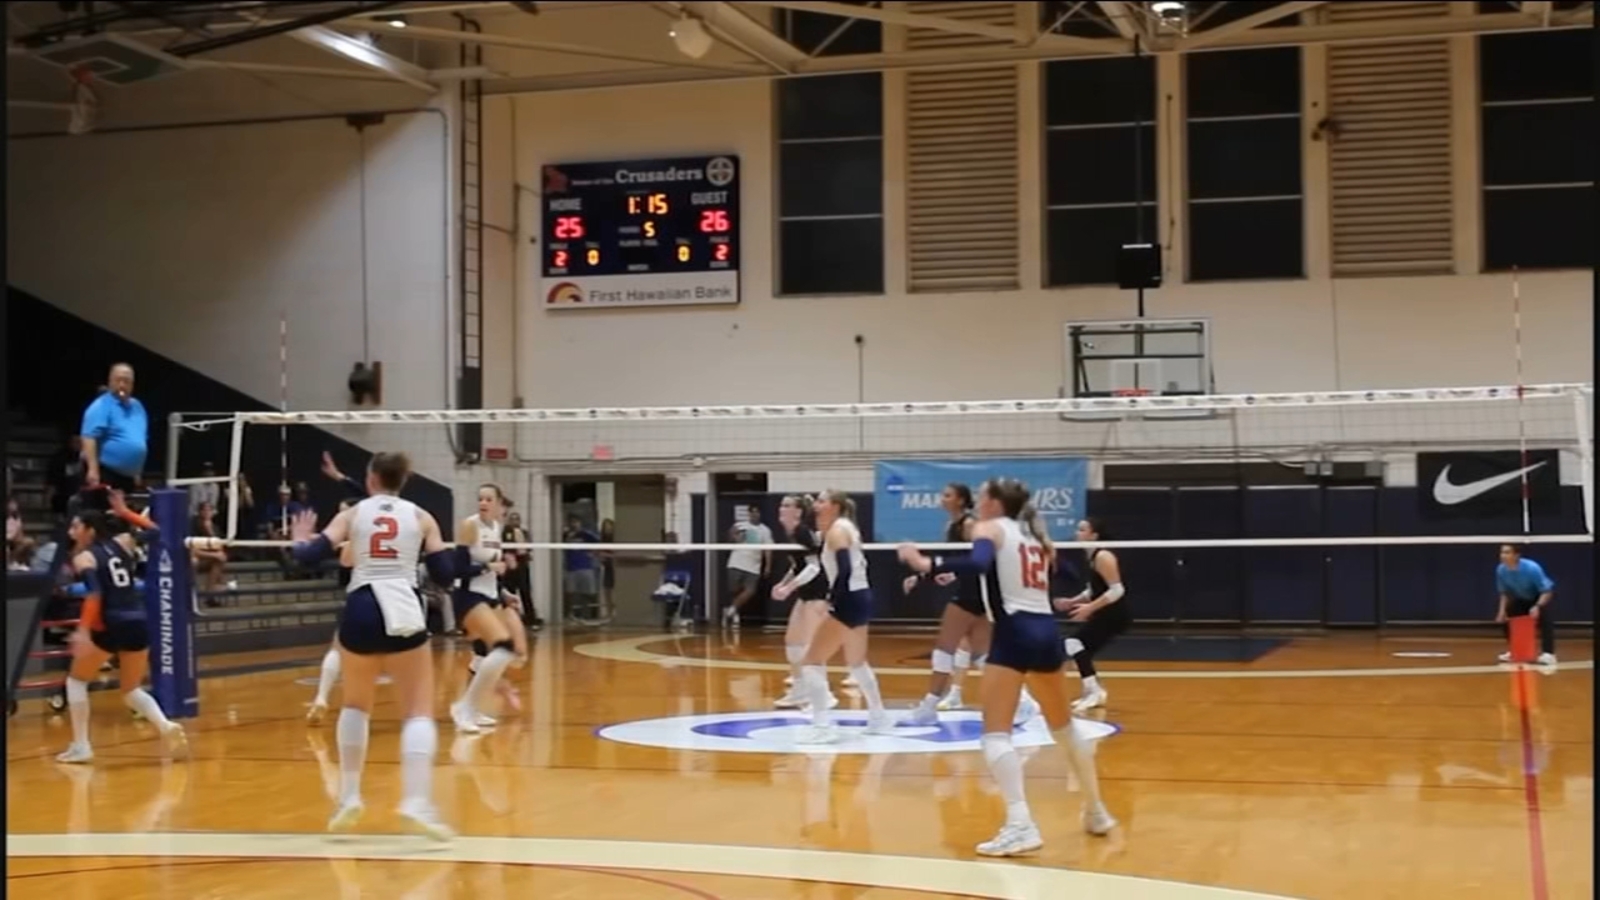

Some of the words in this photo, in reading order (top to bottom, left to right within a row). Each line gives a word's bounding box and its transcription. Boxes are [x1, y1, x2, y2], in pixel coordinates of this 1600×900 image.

[615, 167, 703, 183] Crusaders
[628, 194, 668, 214] 1:15
[691, 191, 728, 205] GUEST
[555, 217, 583, 238] 25
[644, 221, 655, 237] 5
[701, 211, 728, 231] 26
[555, 251, 567, 266] 2
[716, 244, 728, 260] 2
[589, 290, 622, 302] First
[626, 288, 691, 301] Hawaiian
[694, 286, 732, 299] Bank
[369, 516, 398, 558] 2
[108, 556, 131, 588] 6
[1019, 543, 1047, 591] 12
[158, 577, 174, 675] CHAMINADE
